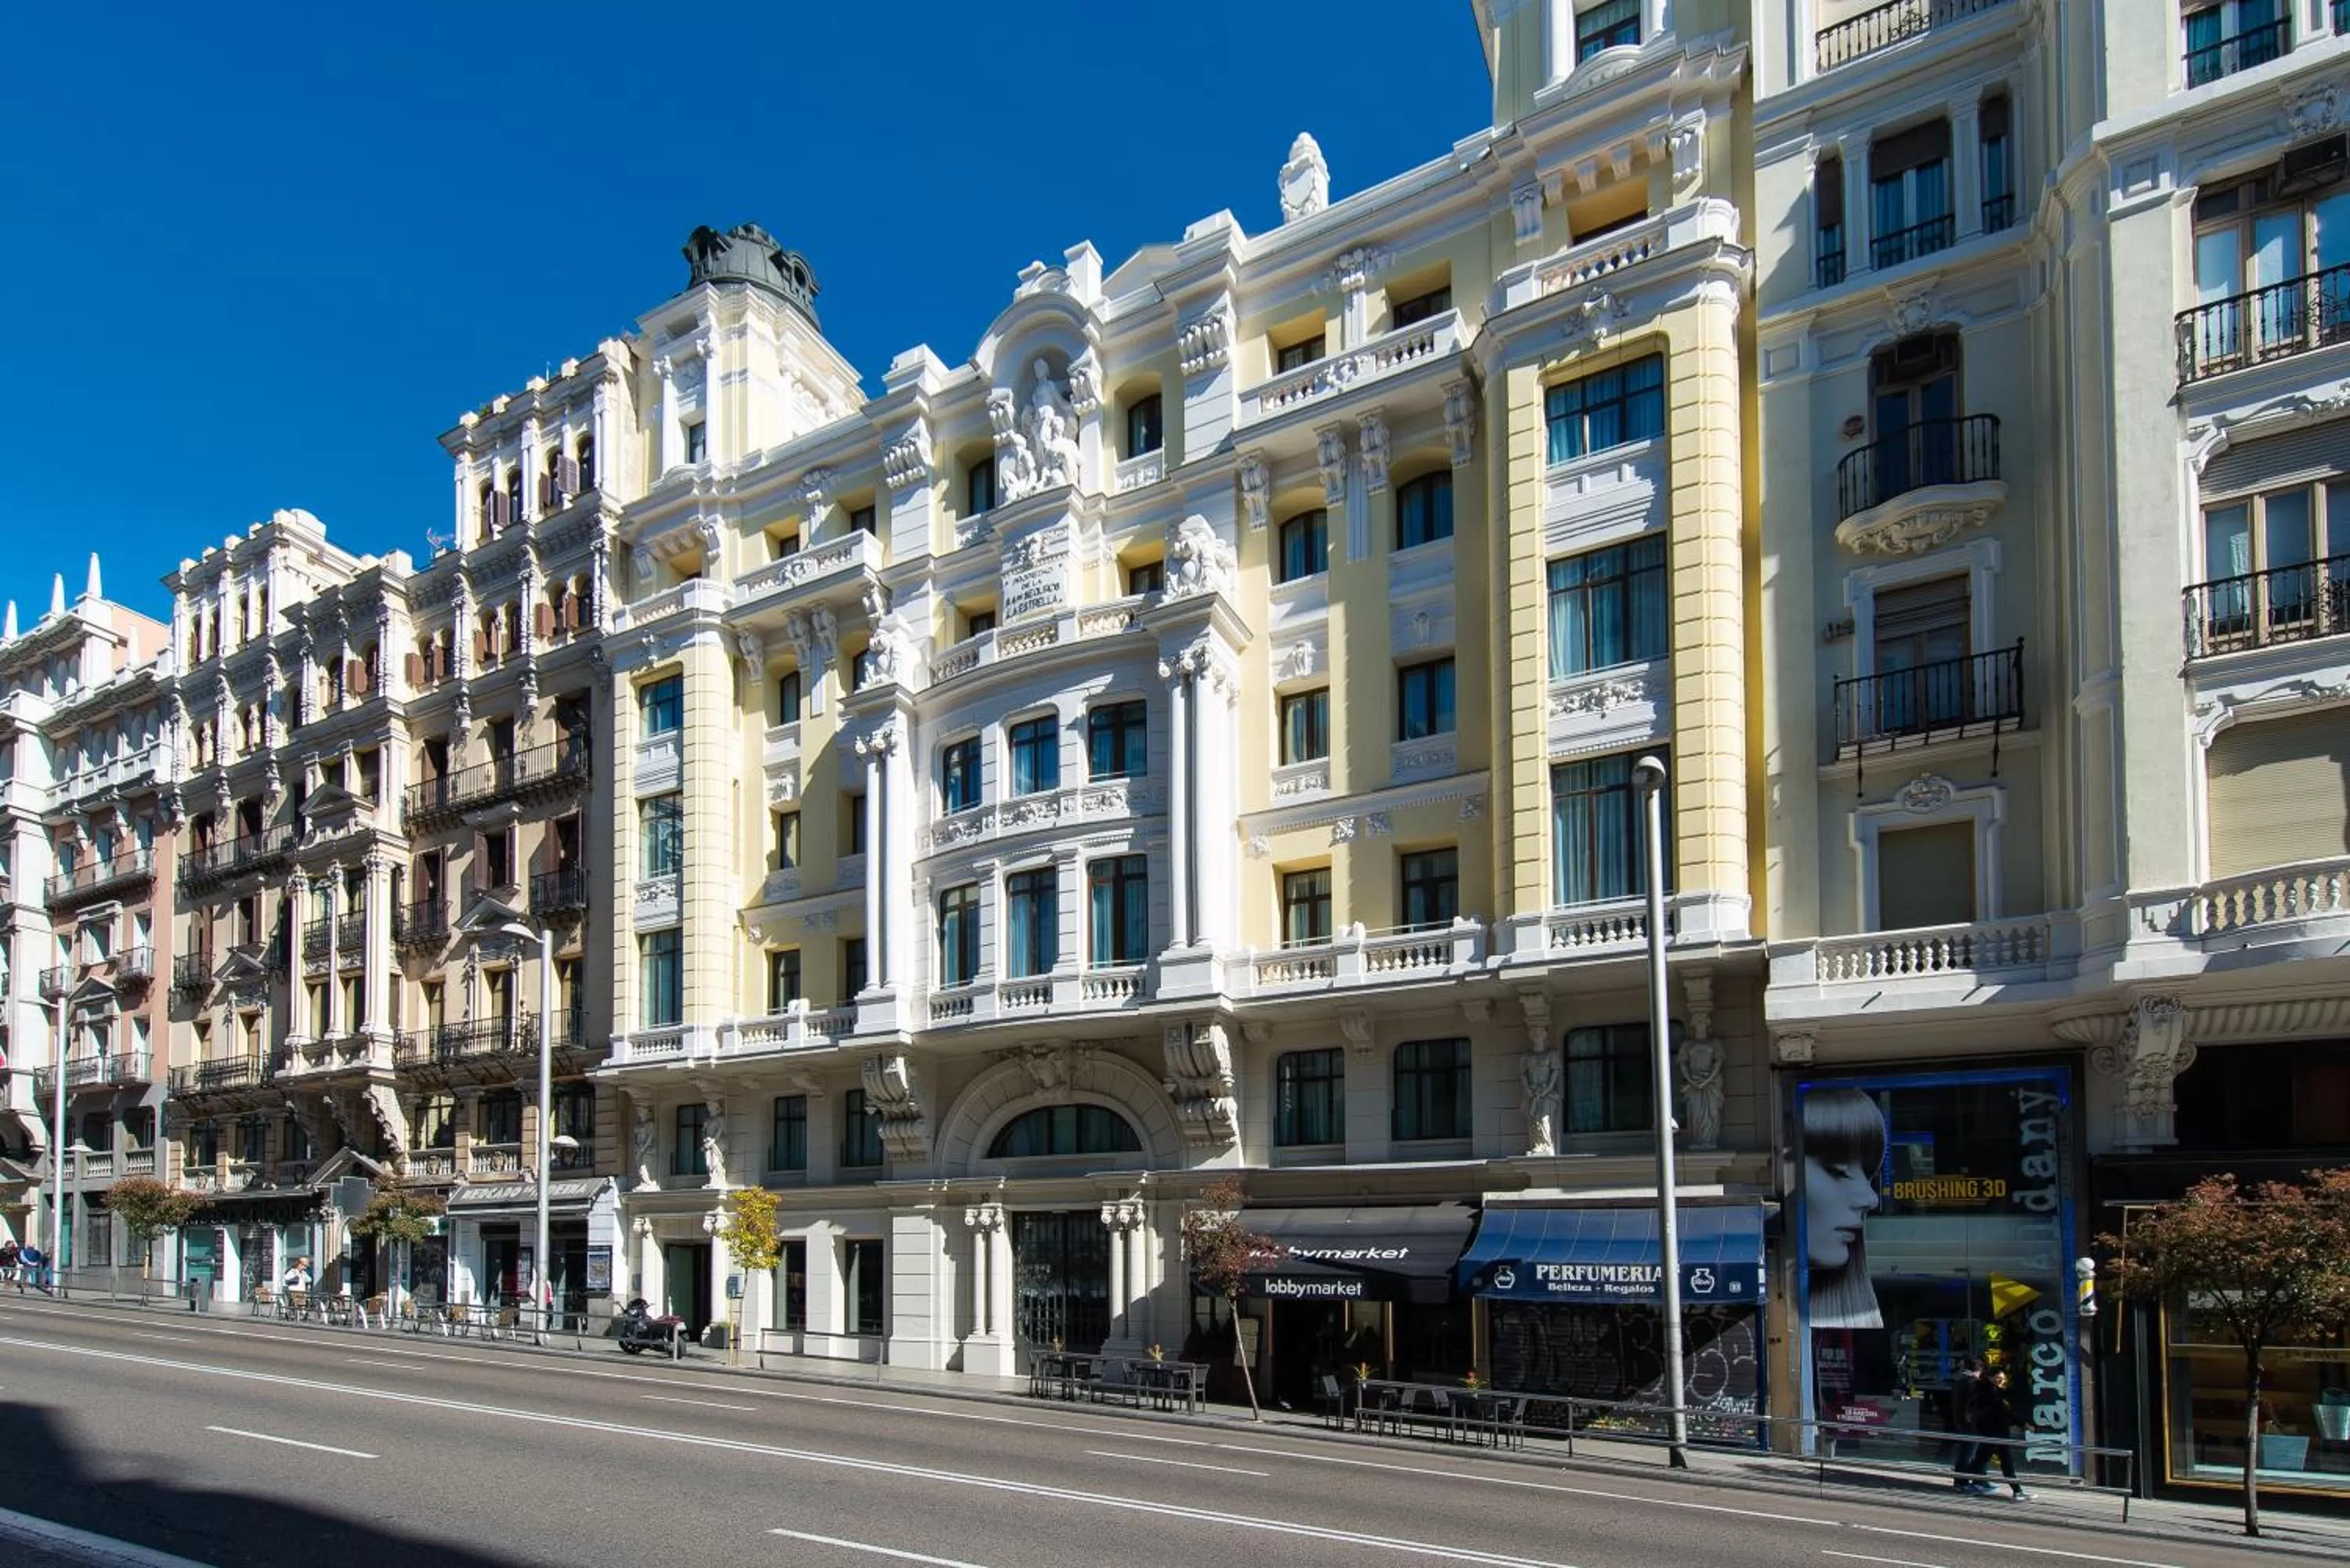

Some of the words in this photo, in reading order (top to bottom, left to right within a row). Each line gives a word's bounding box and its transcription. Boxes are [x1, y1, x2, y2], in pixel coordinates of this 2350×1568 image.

[1893, 1180, 1979, 1200] BRUSHING
[1983, 1178, 2006, 1198] 3D
[1265, 1279, 1362, 1298] lobbymarket
[1548, 1282, 1593, 1292] Belleza
[1604, 1284, 1655, 1295] Regalos
[2026, 1309, 2069, 1465] Marco
